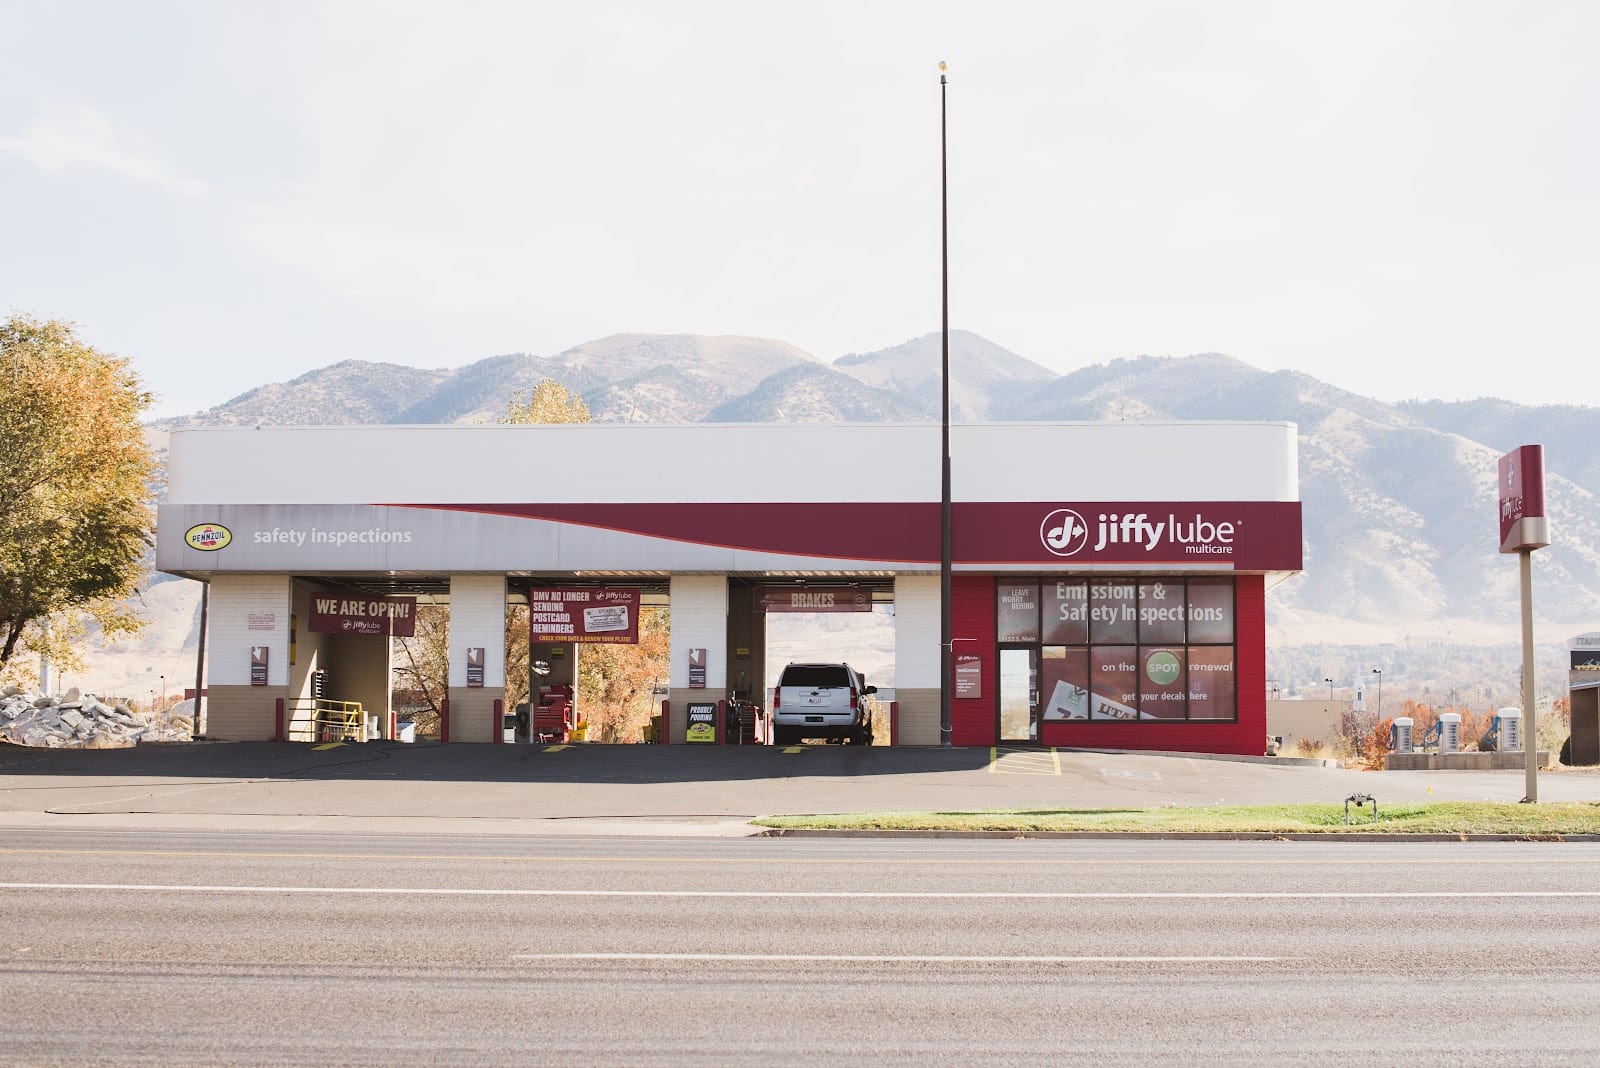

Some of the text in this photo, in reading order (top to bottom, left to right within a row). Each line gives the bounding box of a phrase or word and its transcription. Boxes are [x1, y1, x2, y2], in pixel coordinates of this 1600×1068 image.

[192, 530, 226, 543] PENNZOIL
[253, 527, 412, 547] safety inspections
[1185, 544, 1233, 554] multicare
[1011, 588, 1030, 597] LEAVE
[1056, 581, 1166, 600] Emissions &
[533, 591, 590, 601] DMV NO LONGER
[791, 592, 835, 608] BRAKES
[316, 599, 410, 618] WE ARE OPEN!
[533, 602, 564, 611] SENDING
[1011, 602, 1035, 610] BEHIND
[533, 613, 570, 622] POSTCARD
[1059, 602, 1224, 625] Safety Inspections
[533, 624, 574, 633] REMINDERS
[1101, 662, 1233, 672] on the SPOT renewal
[1122, 691, 1208, 702] get your decals here
[689, 706, 713, 714] PROUDLY
[689, 713, 713, 721] POURING
